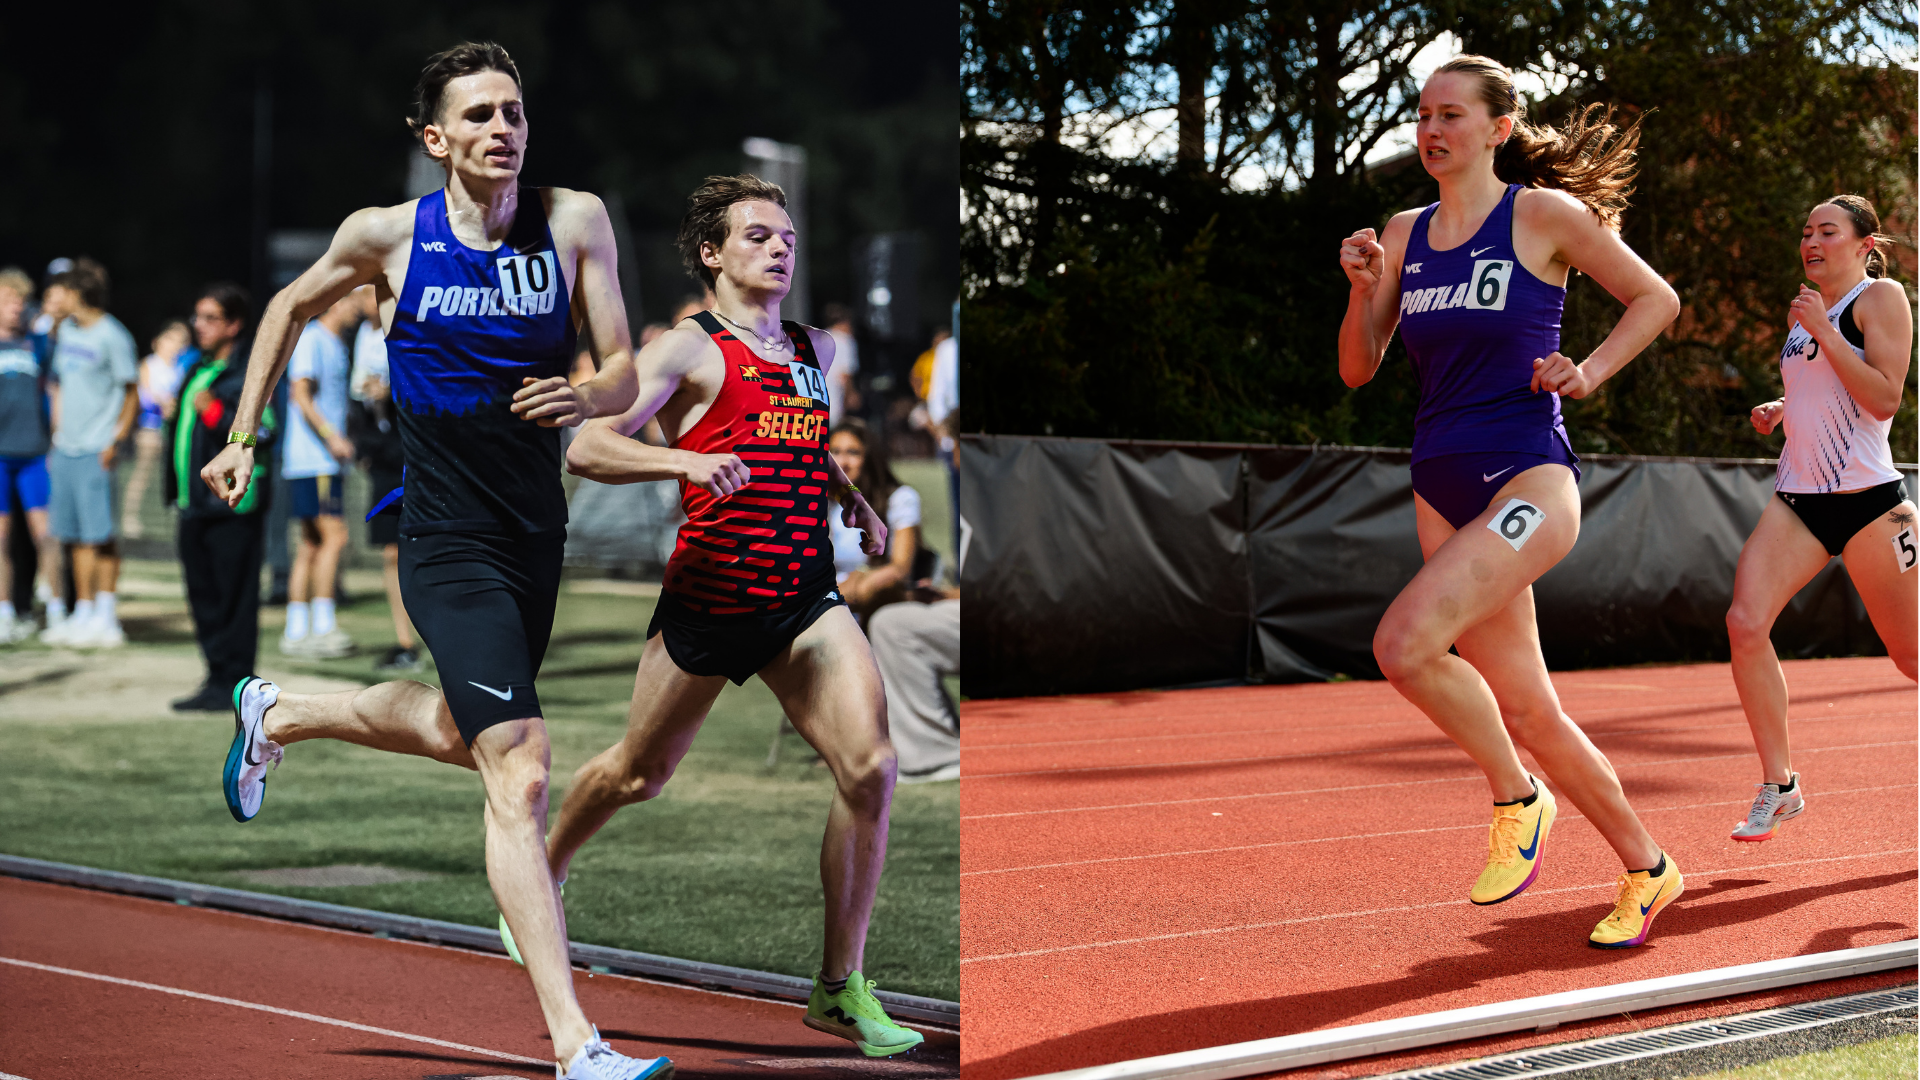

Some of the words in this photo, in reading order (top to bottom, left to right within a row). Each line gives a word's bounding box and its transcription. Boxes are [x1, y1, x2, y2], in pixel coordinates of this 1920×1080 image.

[502, 254, 549, 296] 10
[1476, 262, 1504, 307] 6
[1399, 282, 1469, 322] PORTLA
[797, 366, 824, 401] 14
[756, 411, 824, 442] SELECT
[1500, 504, 1537, 540] 6
[1898, 530, 1917, 568] 5
